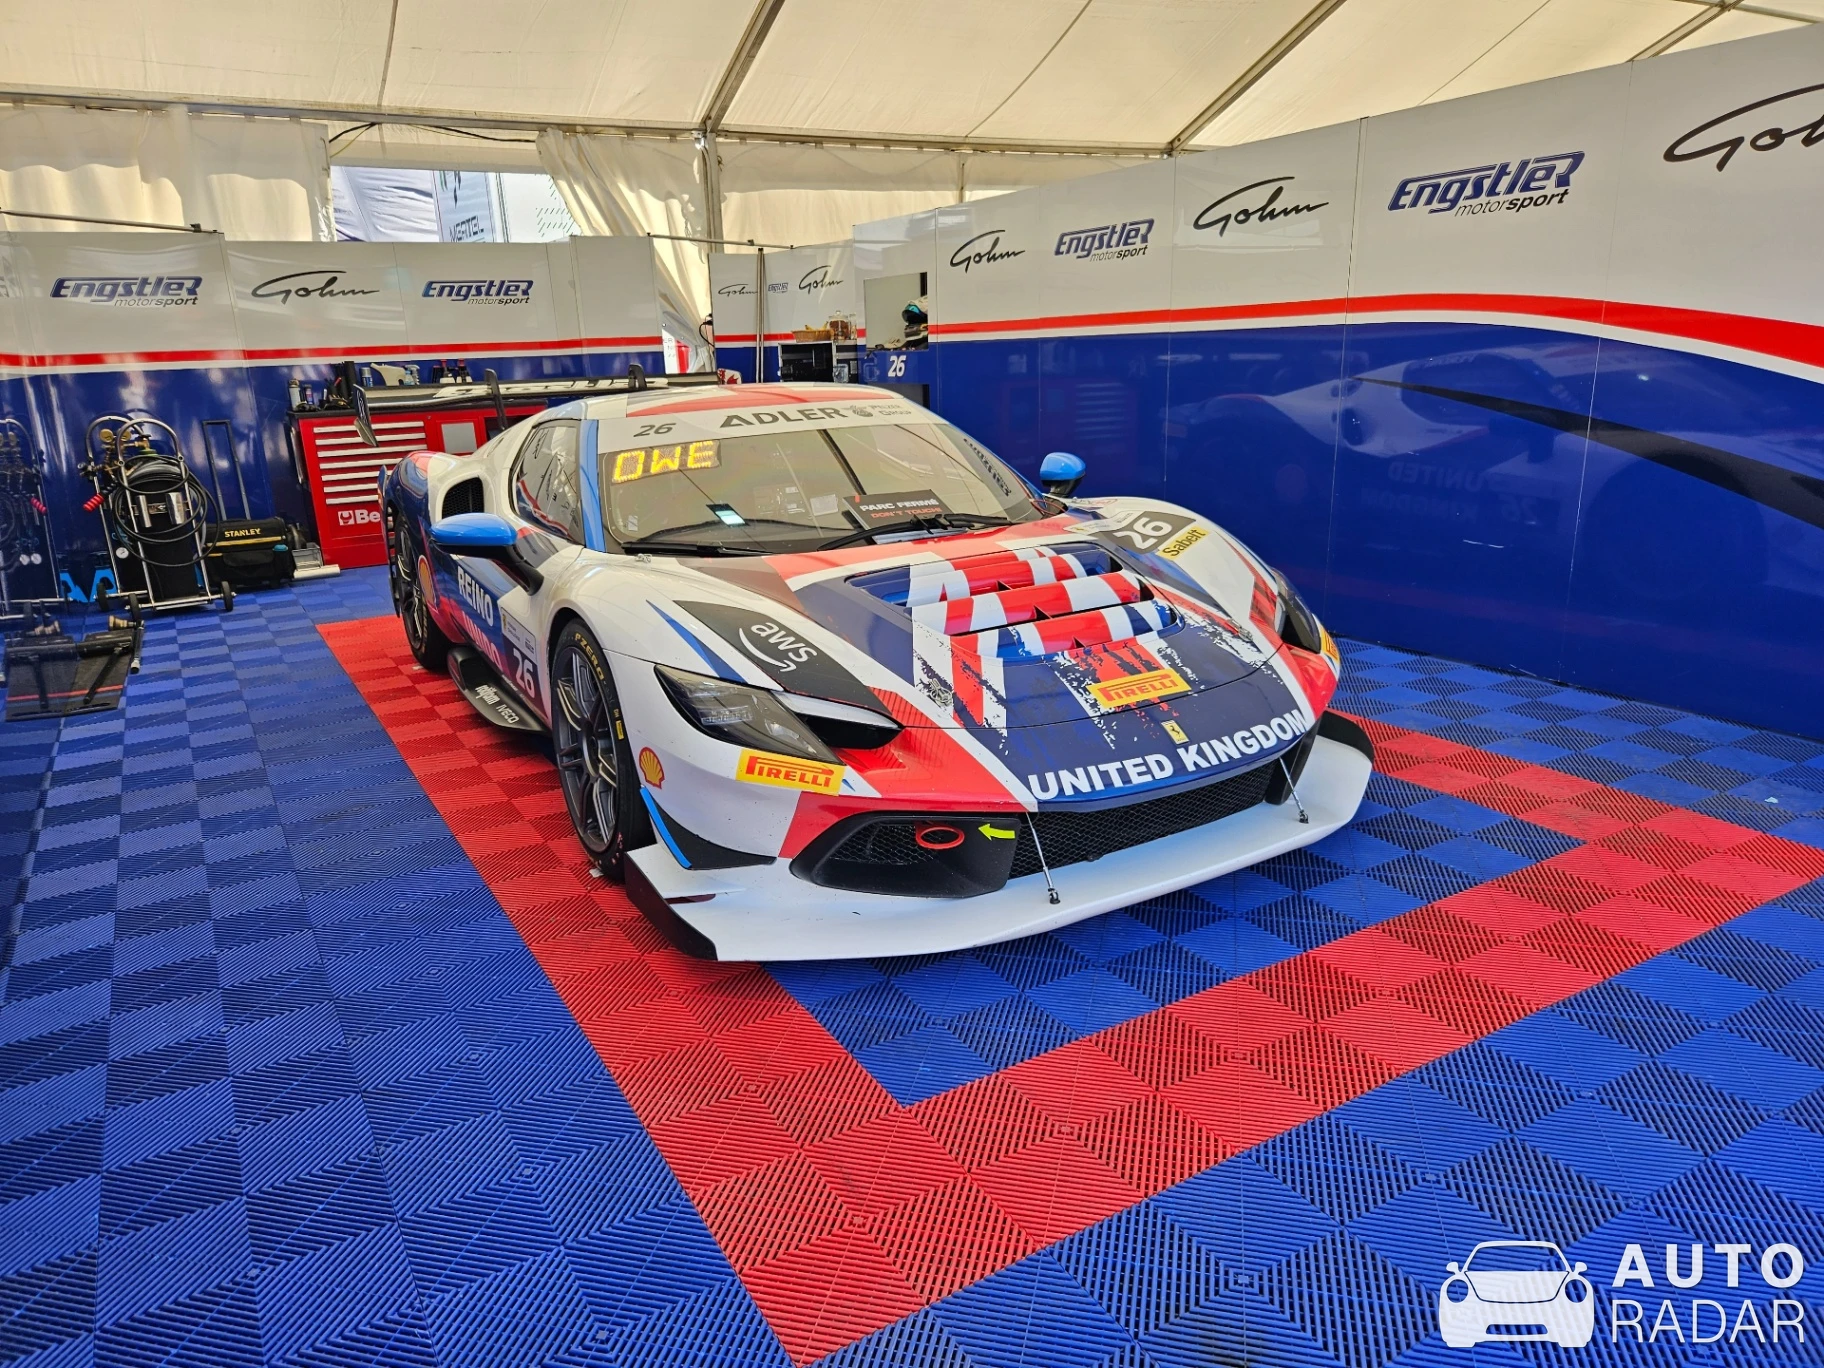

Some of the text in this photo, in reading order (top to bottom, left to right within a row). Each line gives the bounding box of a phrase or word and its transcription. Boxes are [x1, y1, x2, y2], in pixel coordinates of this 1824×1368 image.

[1193, 176, 1329, 237] Gohm
[1454, 189, 1570, 218] motorsport
[950, 229, 1026, 273] Gohm
[1090, 244, 1148, 262] motorsport
[251, 270, 380, 305] Gohm
[717, 283, 759, 298] Gohm
[798, 265, 844, 295] Gohm
[114, 296, 199, 308] motorsport
[467, 296, 530, 306] motorsport
[887, 355, 907, 377] 26
[634, 405, 849, 437] 26 ADLER
[613, 440, 715, 483] OWE
[355, 509, 381, 523] Be
[859, 498, 940, 512] PARC FERMÉ
[870, 510, 903, 518] DON'T
[224, 527, 261, 538] STANLEY
[1113, 517, 1173, 549] 26
[1163, 528, 1207, 557] Sabelt
[457, 566, 494, 627] REINO
[750, 622, 818, 662] aws
[513, 647, 535, 699] 26
[1095, 671, 1177, 705] PIRELLI
[496, 704, 520, 725] IVECO
[1027, 708, 1310, 800] UNITED KINGDOM
[745, 755, 834, 788] PIRELLI
